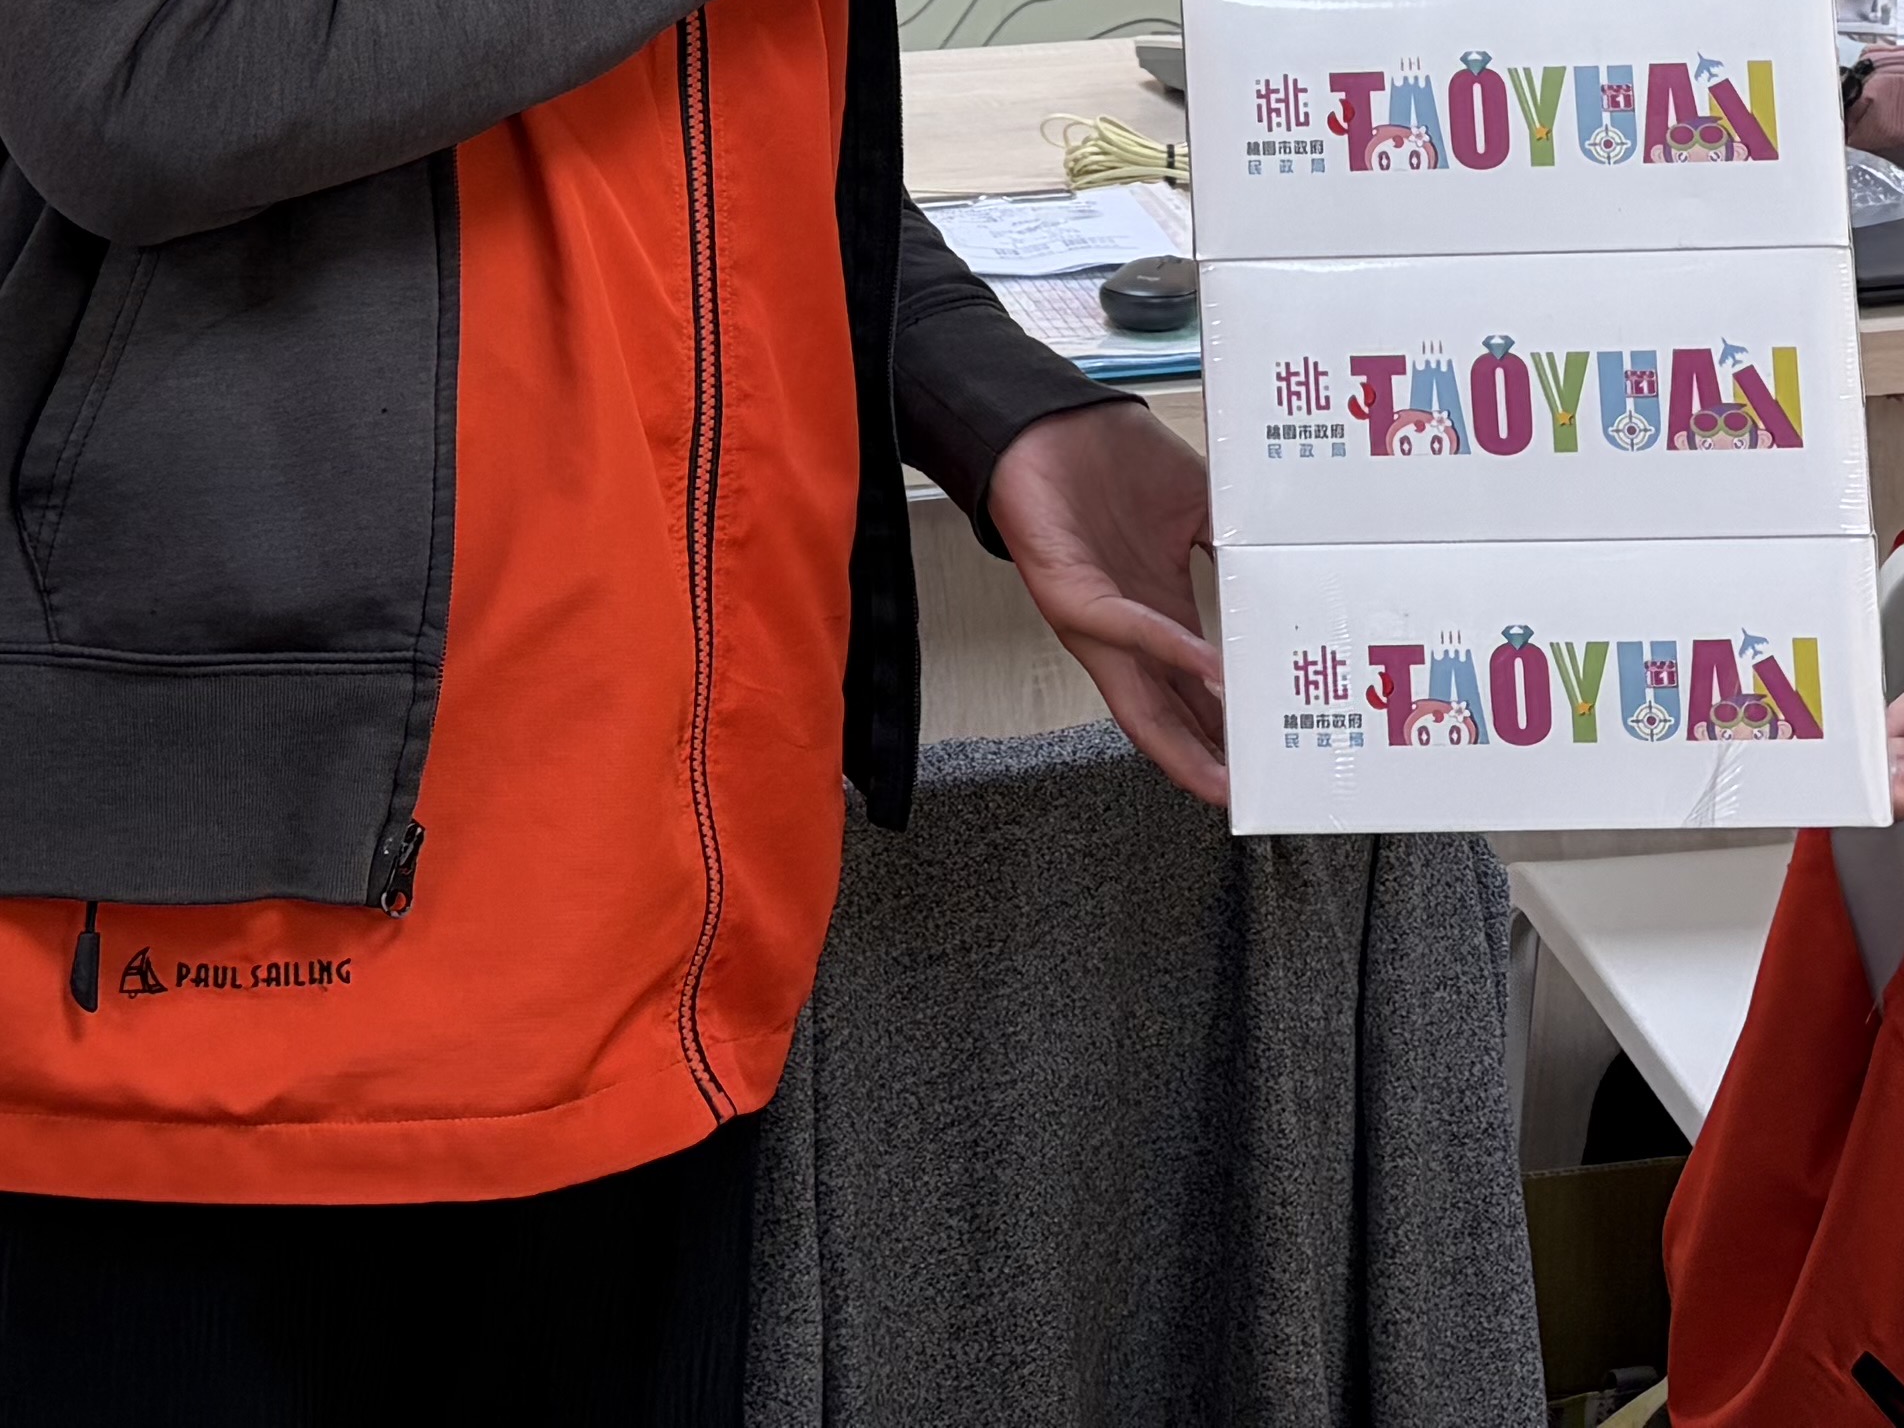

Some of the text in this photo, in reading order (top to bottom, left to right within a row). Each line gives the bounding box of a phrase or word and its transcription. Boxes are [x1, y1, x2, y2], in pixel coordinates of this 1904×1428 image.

[1328, 60, 1780, 172] TAOYUAN
[1246, 139, 1325, 158] 桃園市政府
[1247, 157, 1326, 176] 民政局
[1349, 345, 1805, 457] TAOYUAN
[1265, 422, 1346, 441] 桃園市政府
[1267, 442, 1347, 459] 民政局
[1368, 636, 1826, 747] TAOYUAN
[1283, 712, 1363, 732] 桃園市政府
[1284, 730, 1365, 749] 民政局
[175, 957, 353, 990] PAUL SAILING
